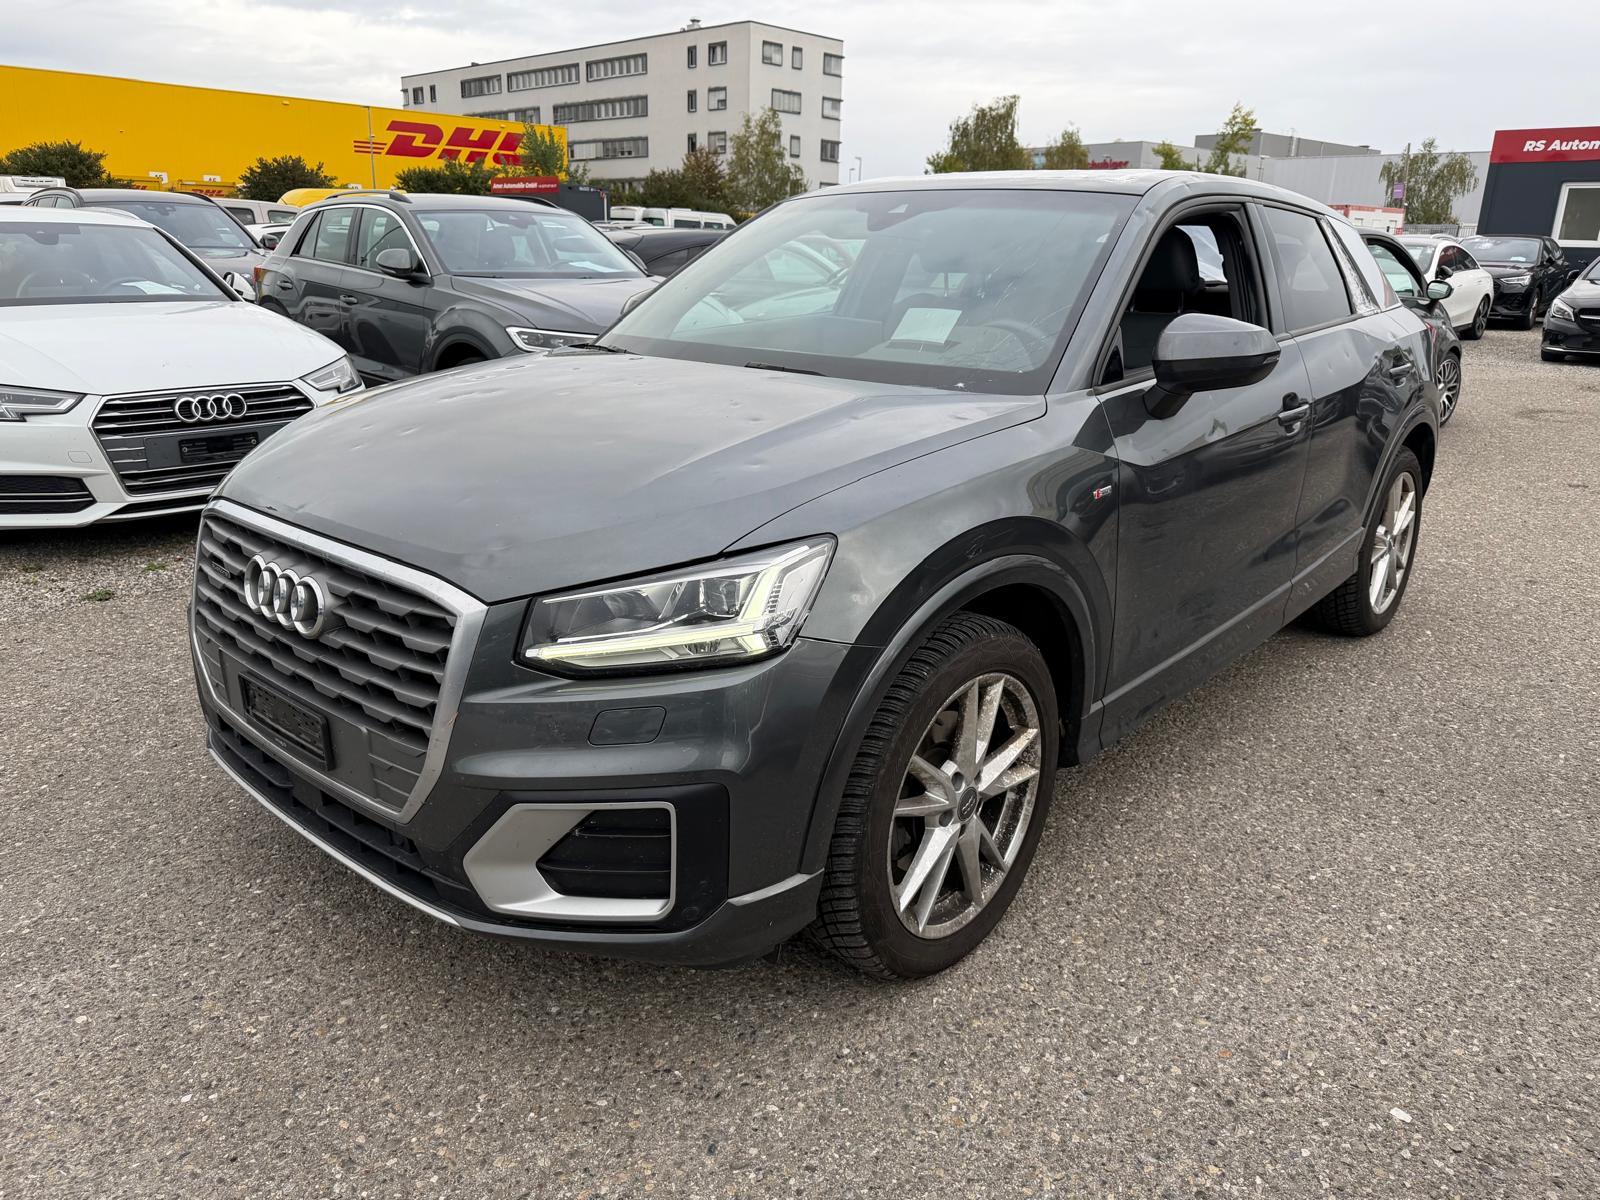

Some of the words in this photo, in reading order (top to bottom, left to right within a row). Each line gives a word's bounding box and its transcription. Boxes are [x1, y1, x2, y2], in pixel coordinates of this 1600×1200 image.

[385, 120, 525, 167] DHL
[1523, 140, 1547, 152] RS
[1547, 139, 1600, 151] Autom
